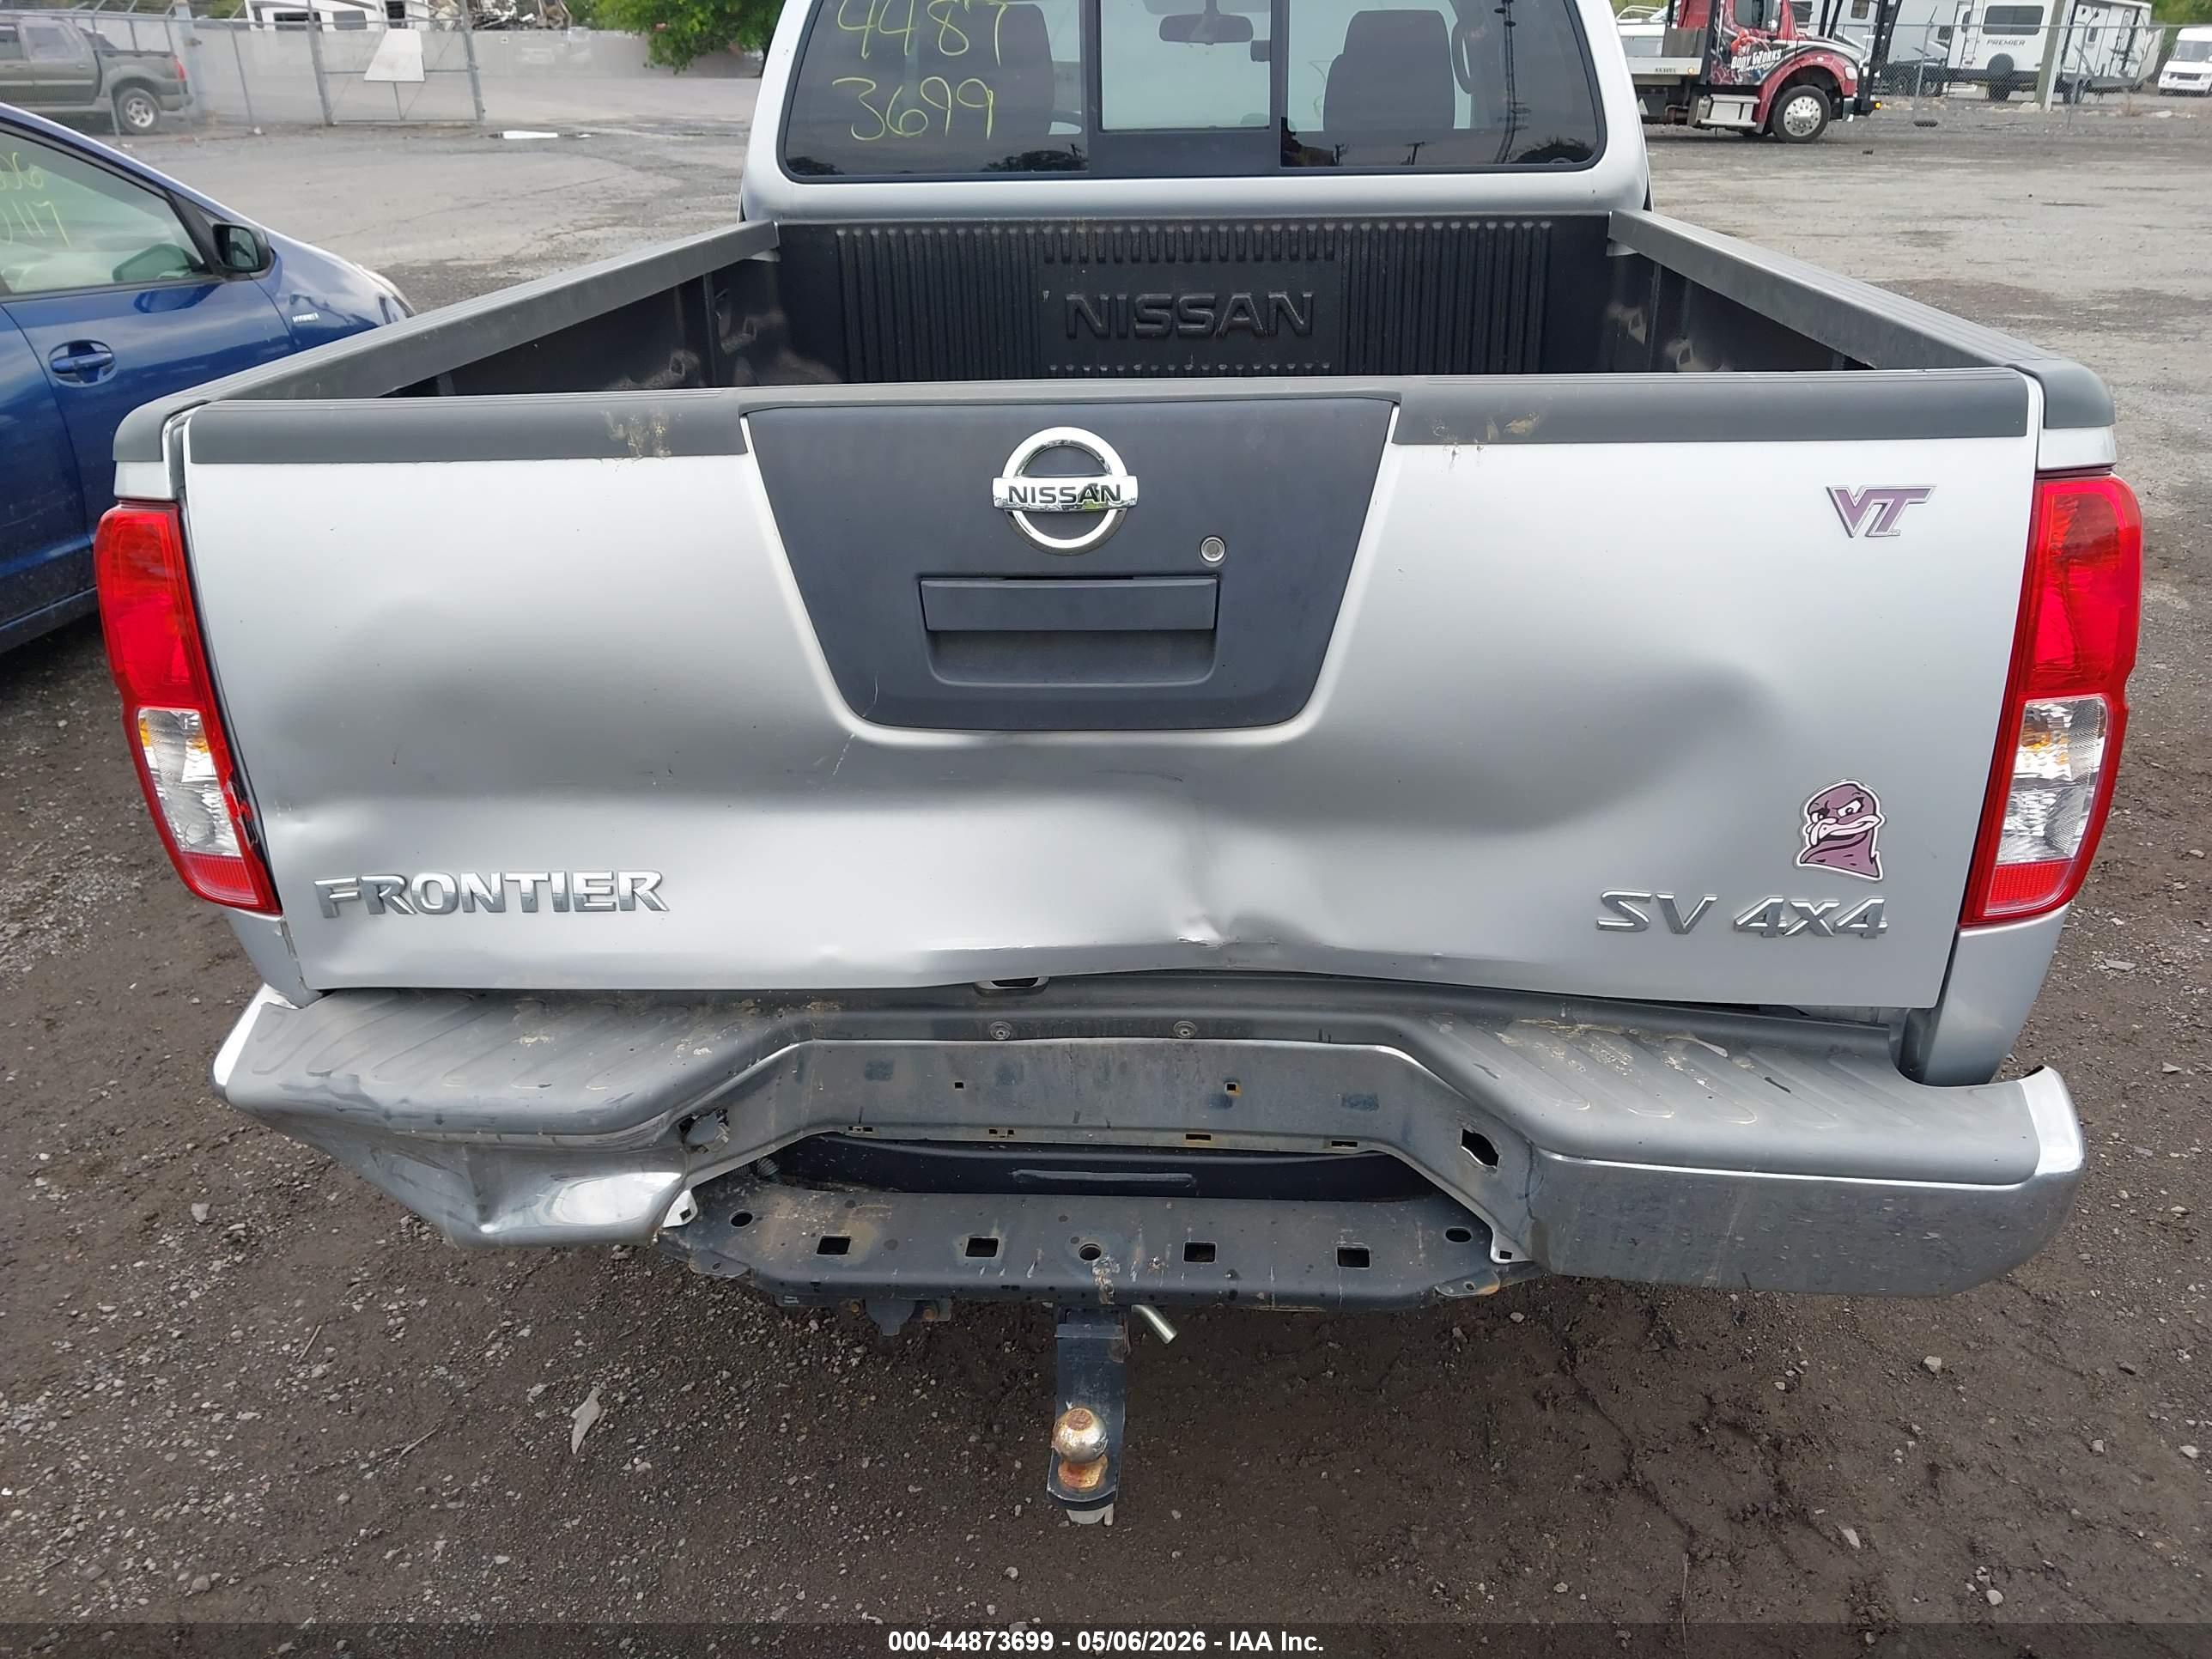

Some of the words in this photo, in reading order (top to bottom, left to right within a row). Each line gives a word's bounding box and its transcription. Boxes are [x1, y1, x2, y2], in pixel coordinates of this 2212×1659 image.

[837, 0, 1009, 67] 4487
[1731, 54, 1752, 69] BODY
[831, 76, 994, 140] 3699
[1065, 291, 1314, 339] NISSAN
[1008, 483, 1121, 505] NISSAN
[1825, 484, 1937, 538] VT
[313, 870, 671, 919] FRONTIER
[1595, 890, 1718, 935] SV
